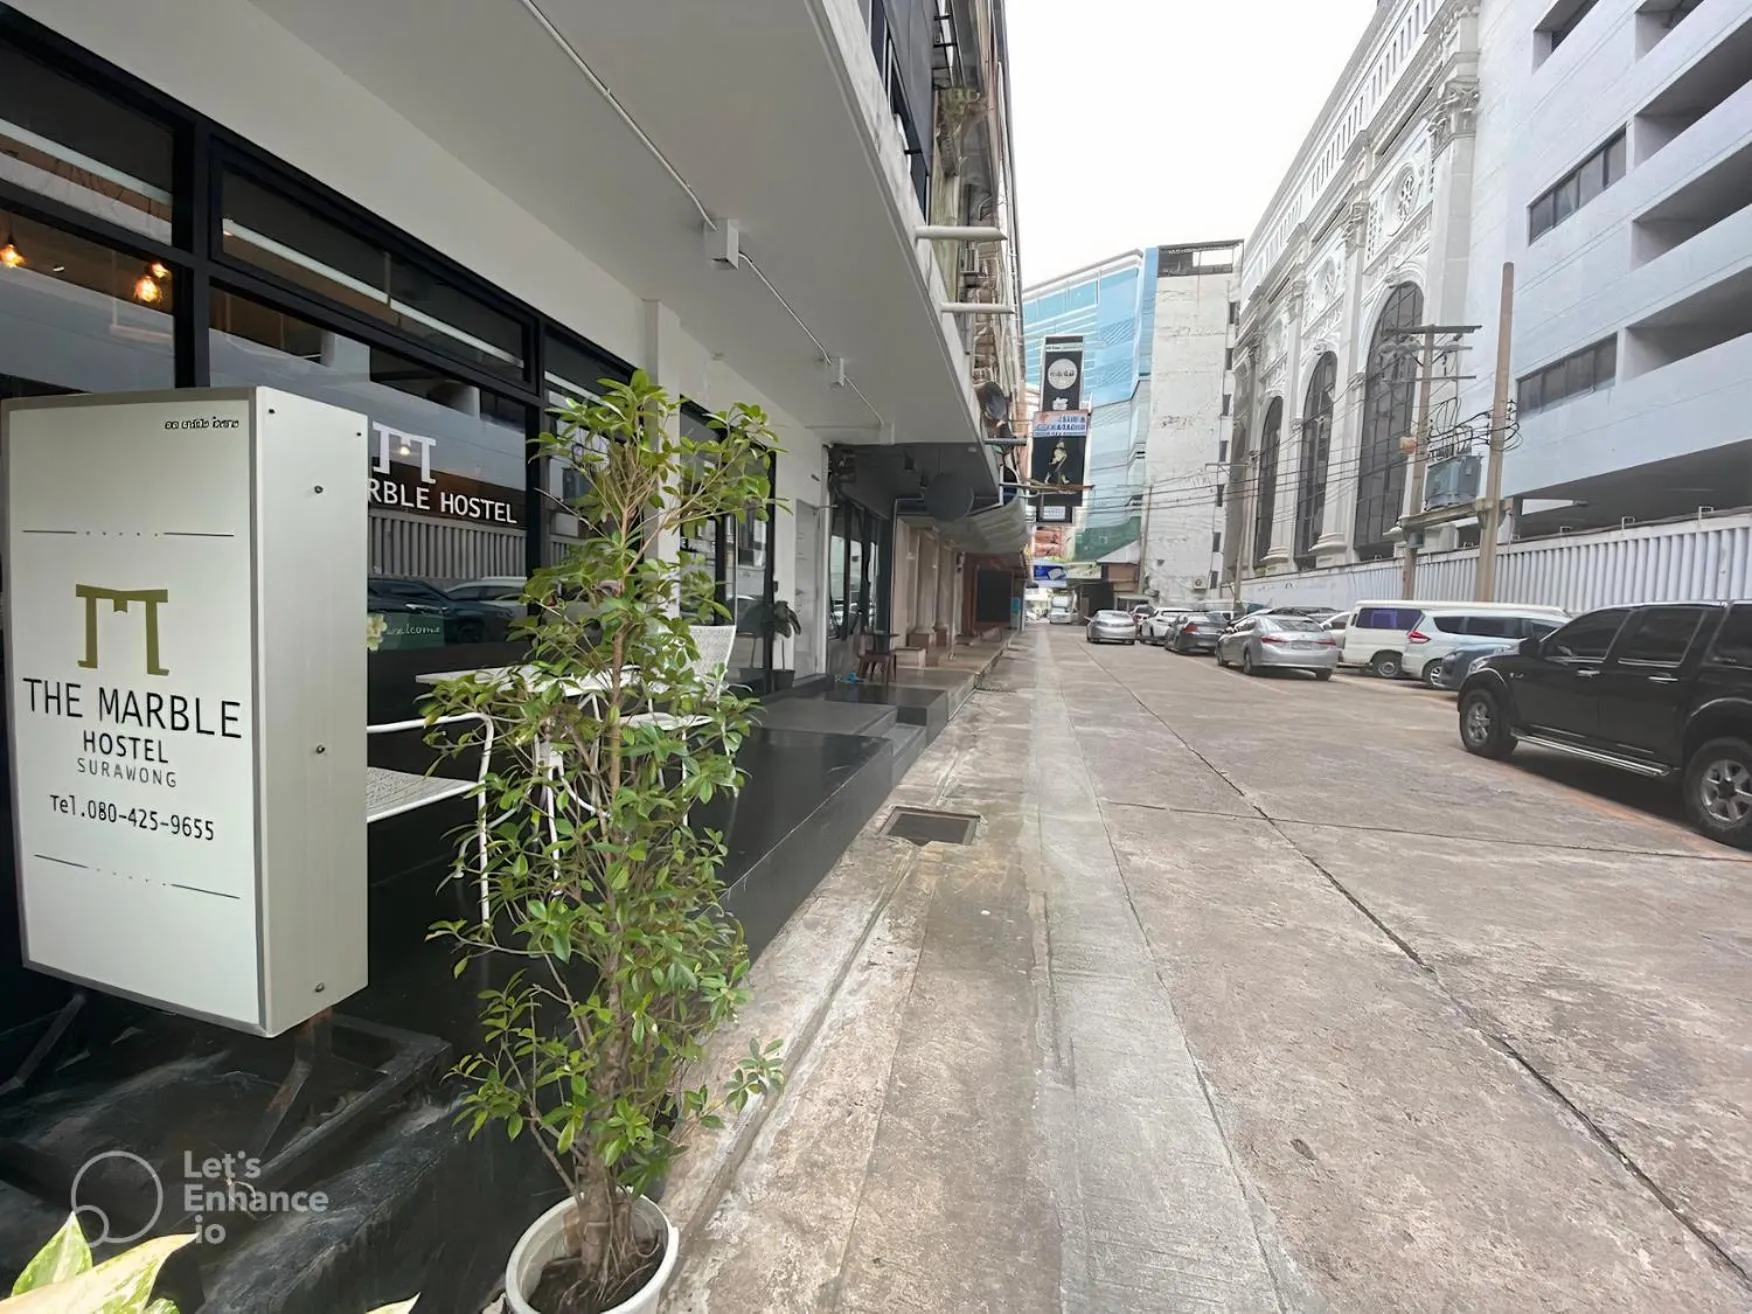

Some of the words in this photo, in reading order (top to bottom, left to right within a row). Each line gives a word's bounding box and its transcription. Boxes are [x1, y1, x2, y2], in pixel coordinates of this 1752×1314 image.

[369, 478, 430, 510] RBLE
[440, 491, 517, 524] HOSTEL
[22, 677, 83, 719] THE
[98, 686, 243, 738] MARBLE
[83, 730, 168, 763] HOSTEL
[77, 758, 176, 788] SURAWONG
